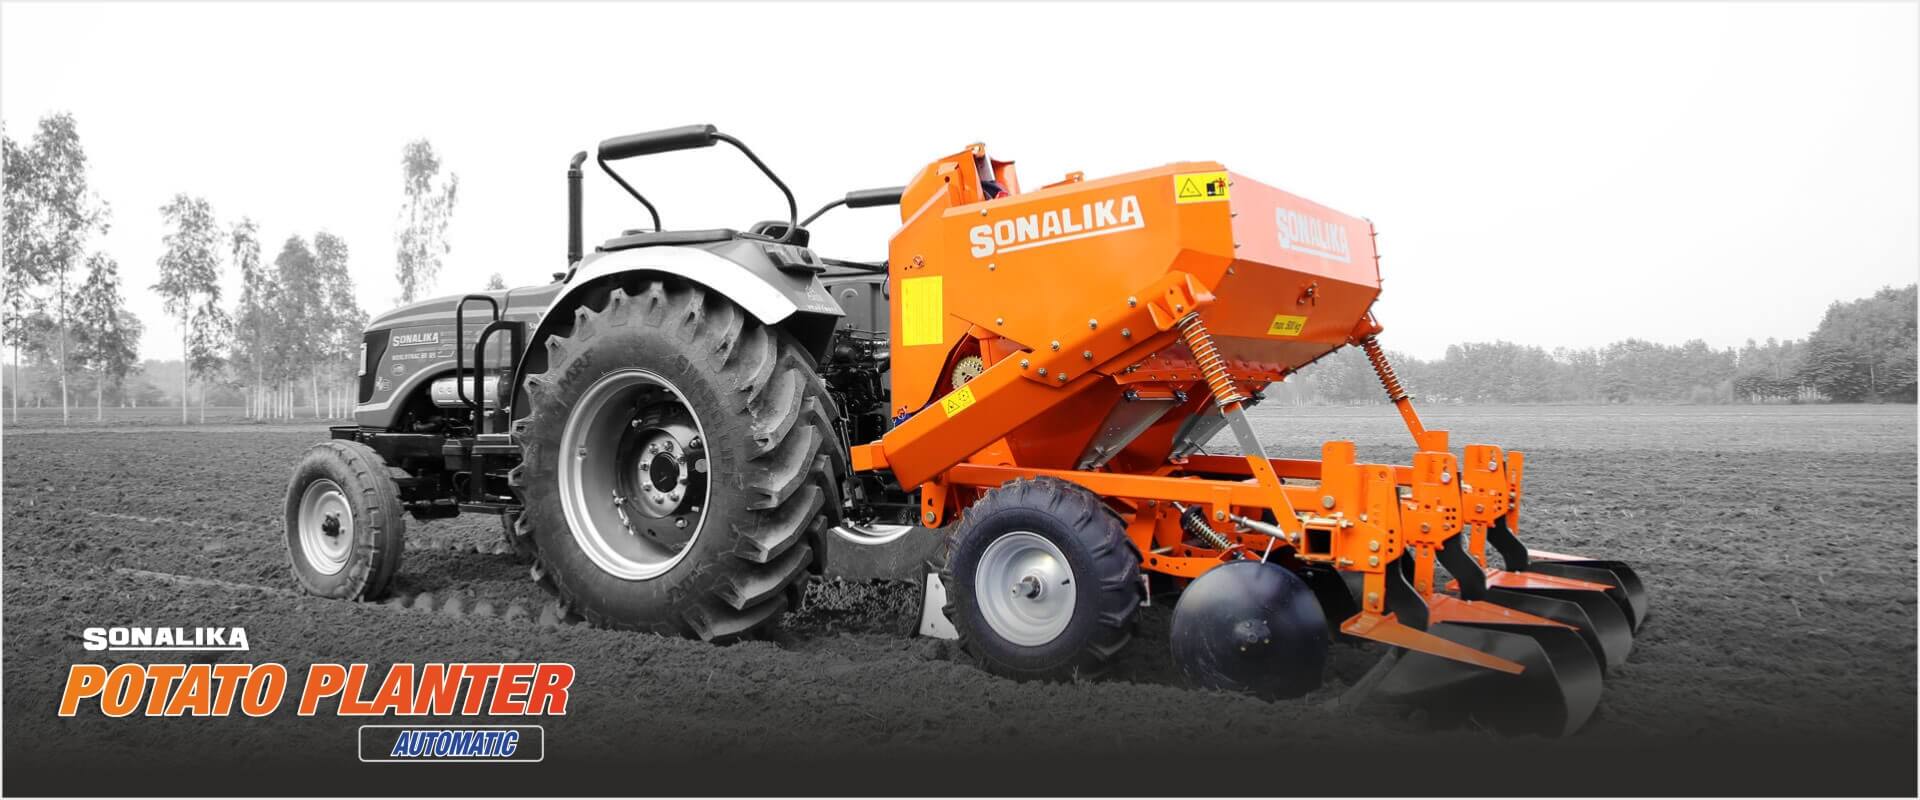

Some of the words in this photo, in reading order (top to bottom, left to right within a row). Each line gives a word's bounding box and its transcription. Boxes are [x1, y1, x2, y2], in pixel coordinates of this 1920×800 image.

[969, 195, 1145, 258] SONALIKA
[1275, 207, 1352, 264] SONALIKA
[392, 332, 439, 347] SONALIKA
